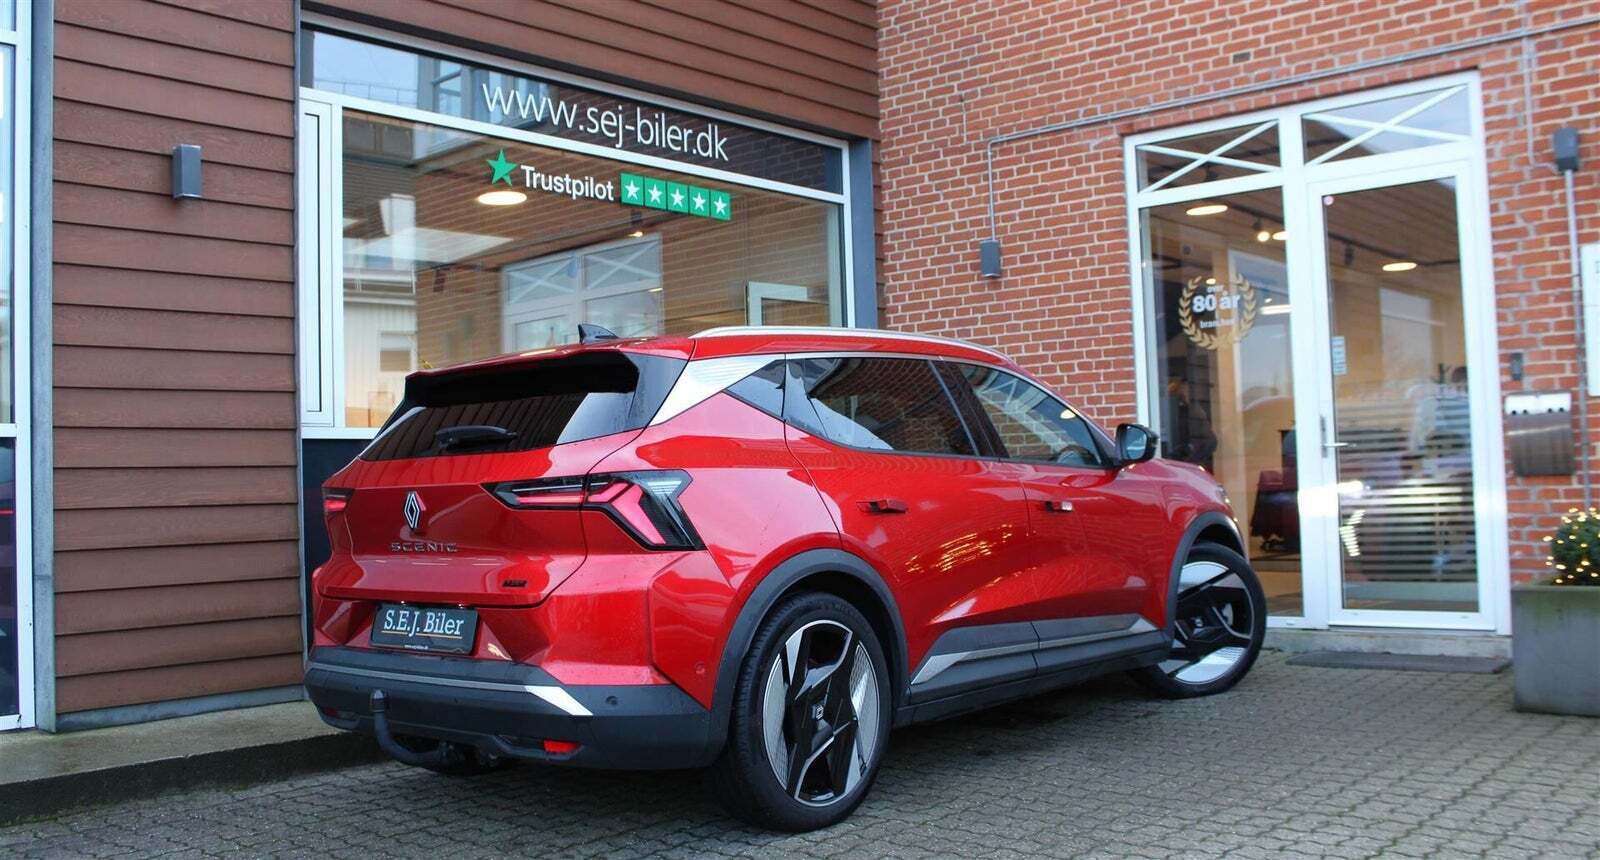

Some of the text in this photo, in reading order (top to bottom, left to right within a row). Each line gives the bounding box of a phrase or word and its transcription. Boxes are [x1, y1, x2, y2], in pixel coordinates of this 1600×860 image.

[482, 83, 729, 161] www.sej-biler.dk
[521, 165, 615, 201] Trustpilot
[1192, 290, 1241, 312] 80 år
[391, 542, 458, 553] SCENIC
[383, 609, 464, 637] S.E.J. Biler
